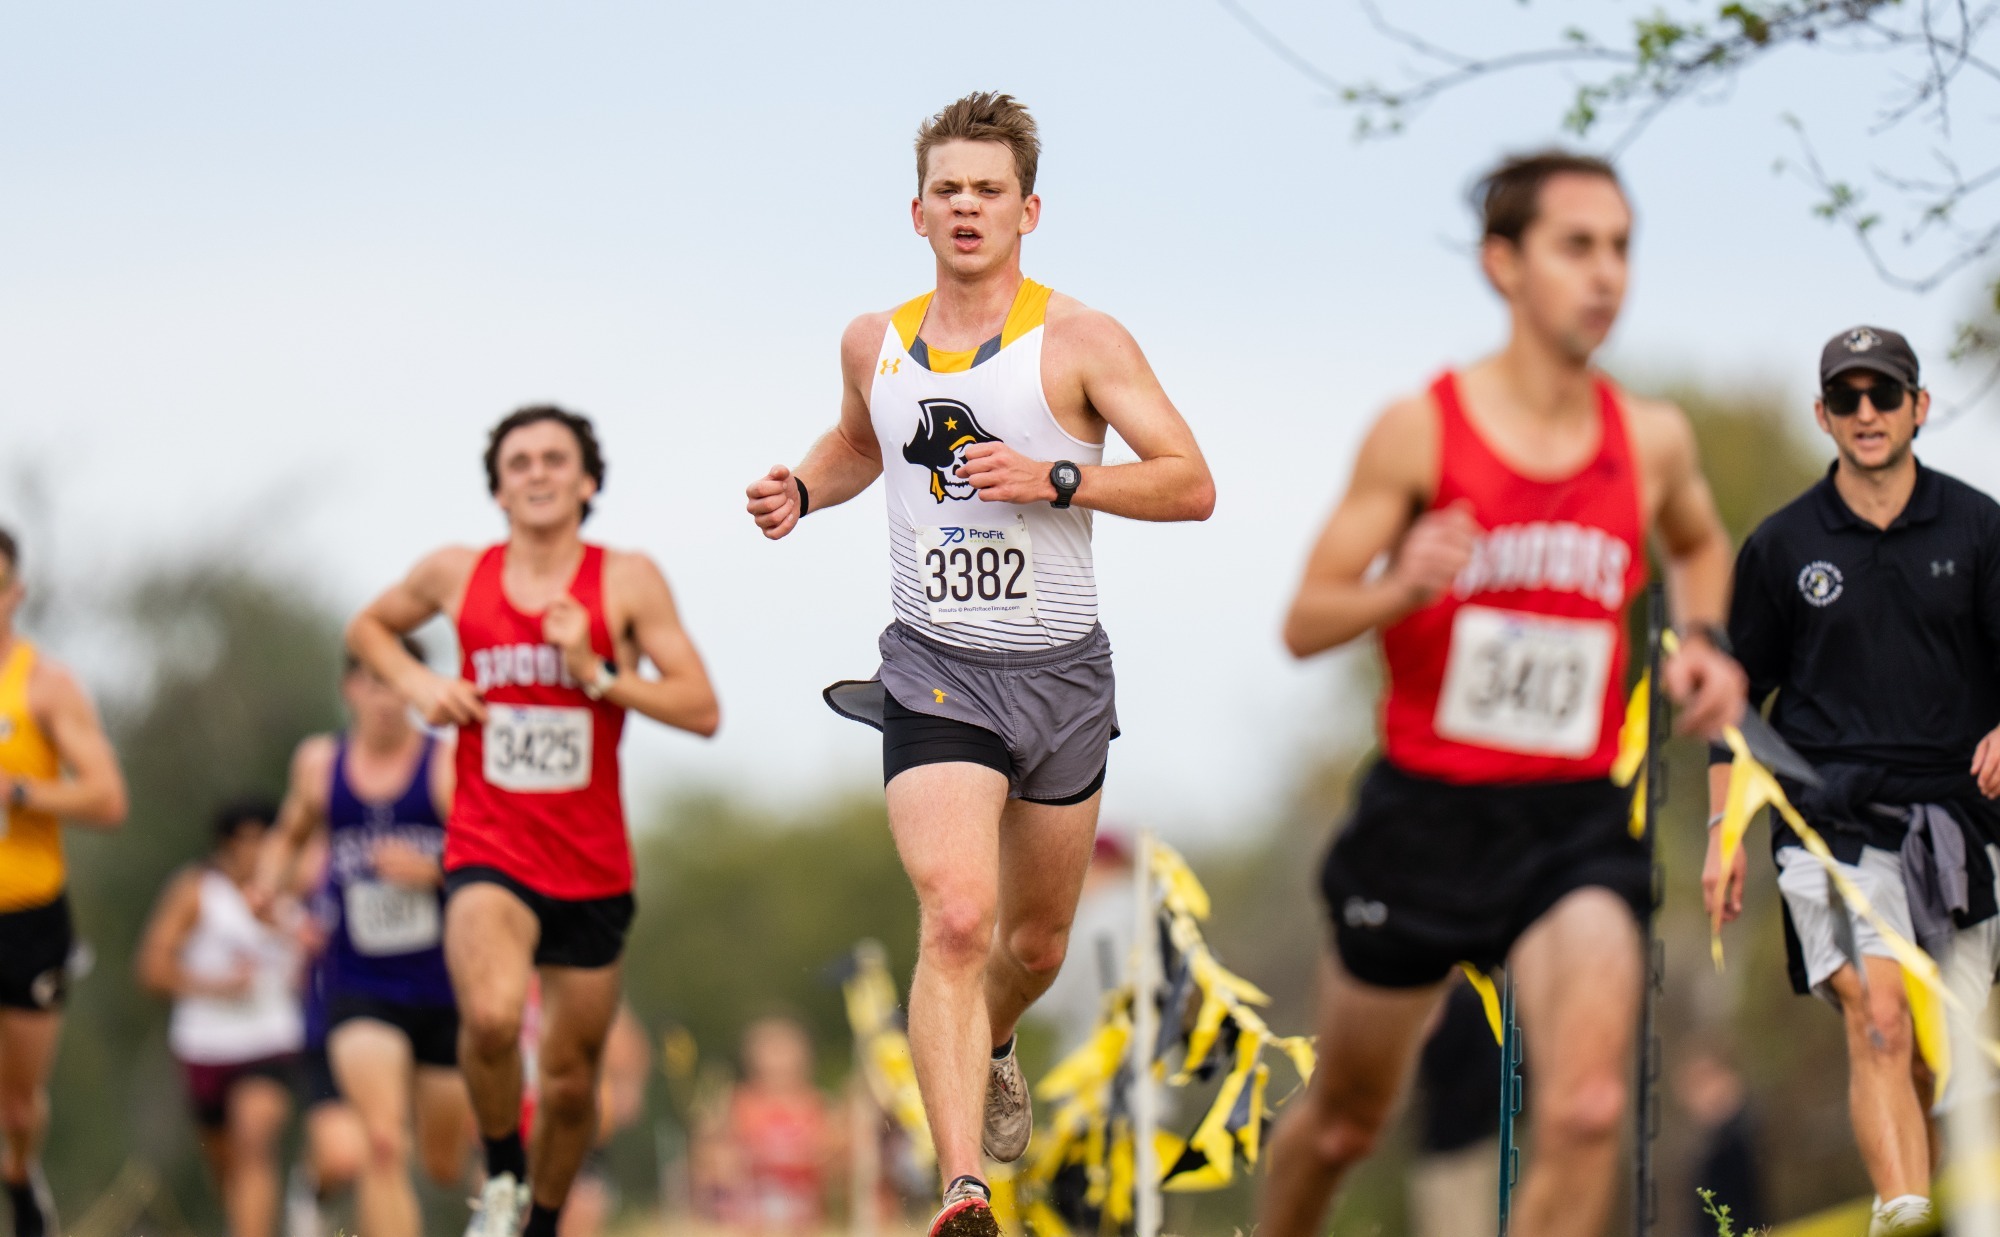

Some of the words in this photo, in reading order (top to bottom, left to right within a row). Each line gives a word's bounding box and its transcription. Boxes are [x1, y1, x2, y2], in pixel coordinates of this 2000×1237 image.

[969, 528, 1005, 540] ProFit
[925, 547, 1028, 603] 3382
[494, 725, 581, 774] 3425
